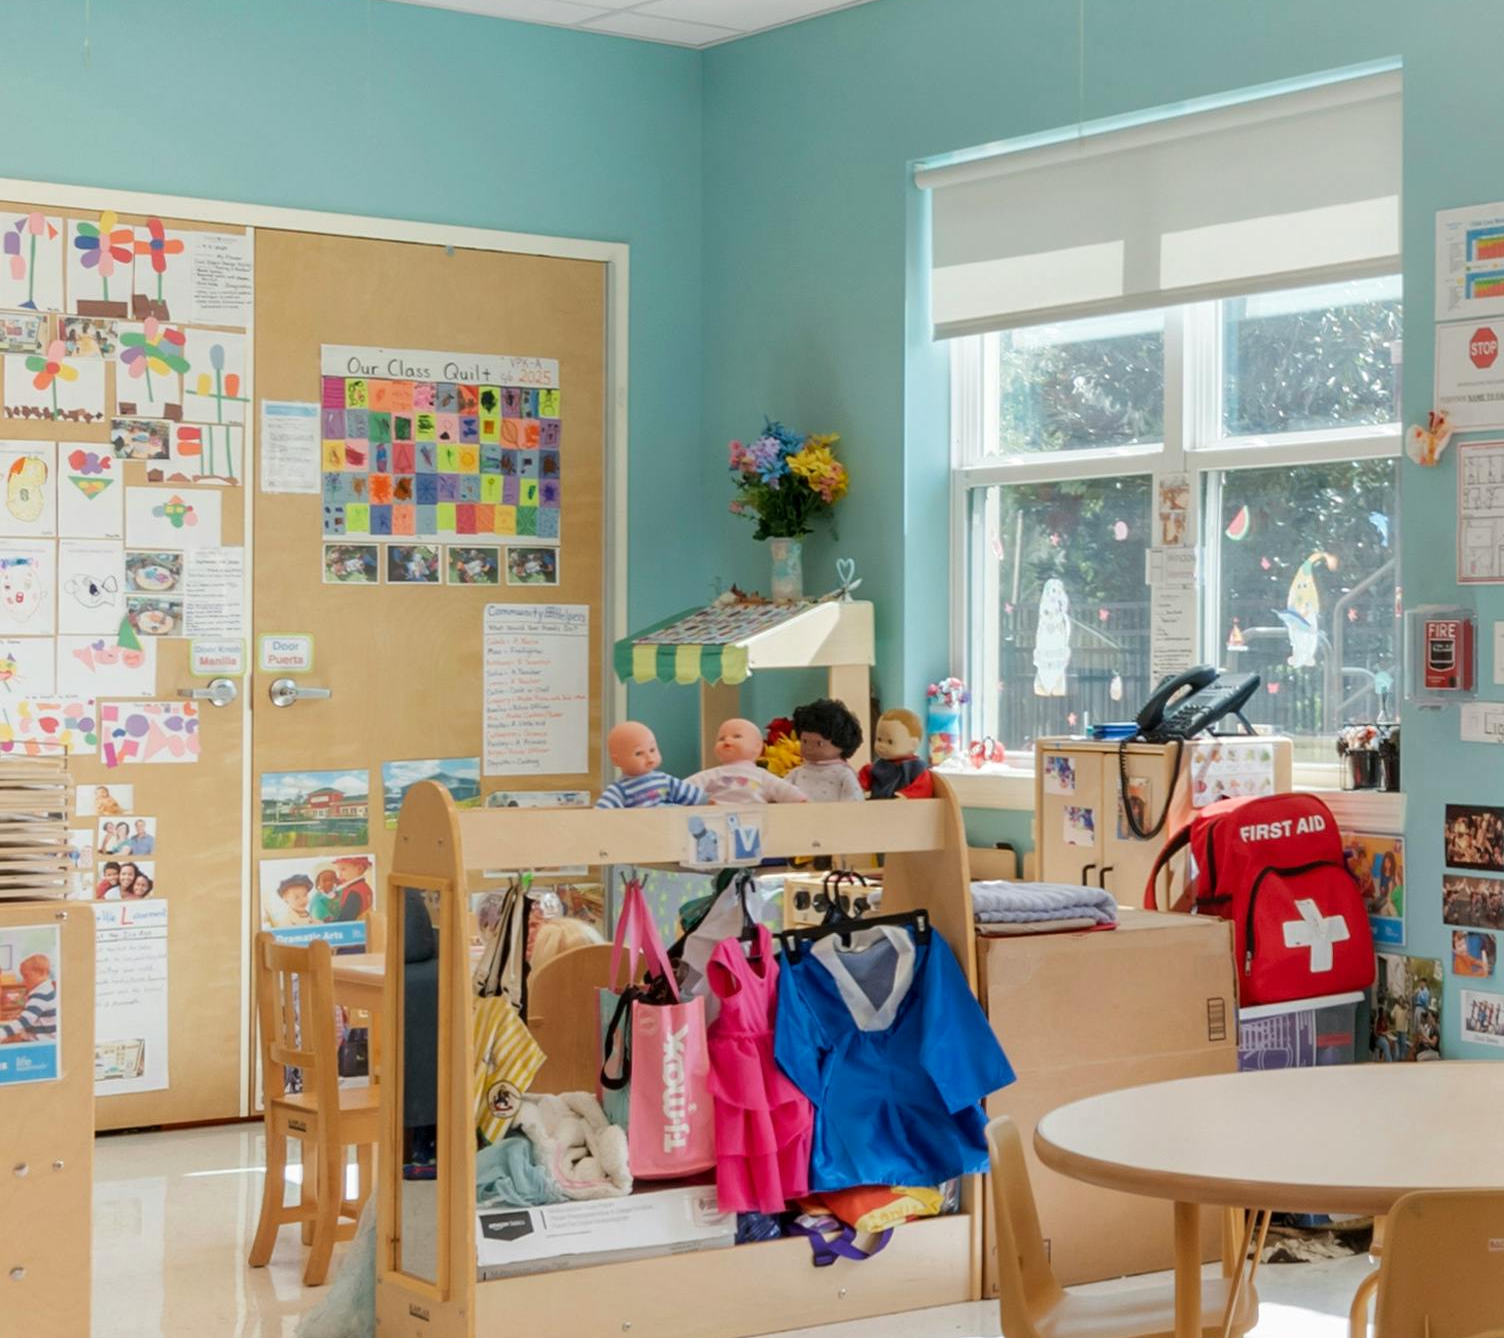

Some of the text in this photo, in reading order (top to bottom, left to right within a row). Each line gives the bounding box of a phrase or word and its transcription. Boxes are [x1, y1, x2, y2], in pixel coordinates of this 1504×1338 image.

[1470, 342, 1497, 357] STOP
[346, 357, 378, 375] Our
[387, 359, 431, 378] Class
[444, 363, 492, 382] Quilt
[519, 369, 552, 385] 2025
[1428, 624, 1456, 638] FIRE
[272, 641, 298, 651] Door
[268, 654, 304, 665] Puerta
[1239, 815, 1326, 843] FIRST AID
[322, 931, 343, 941] Arts
